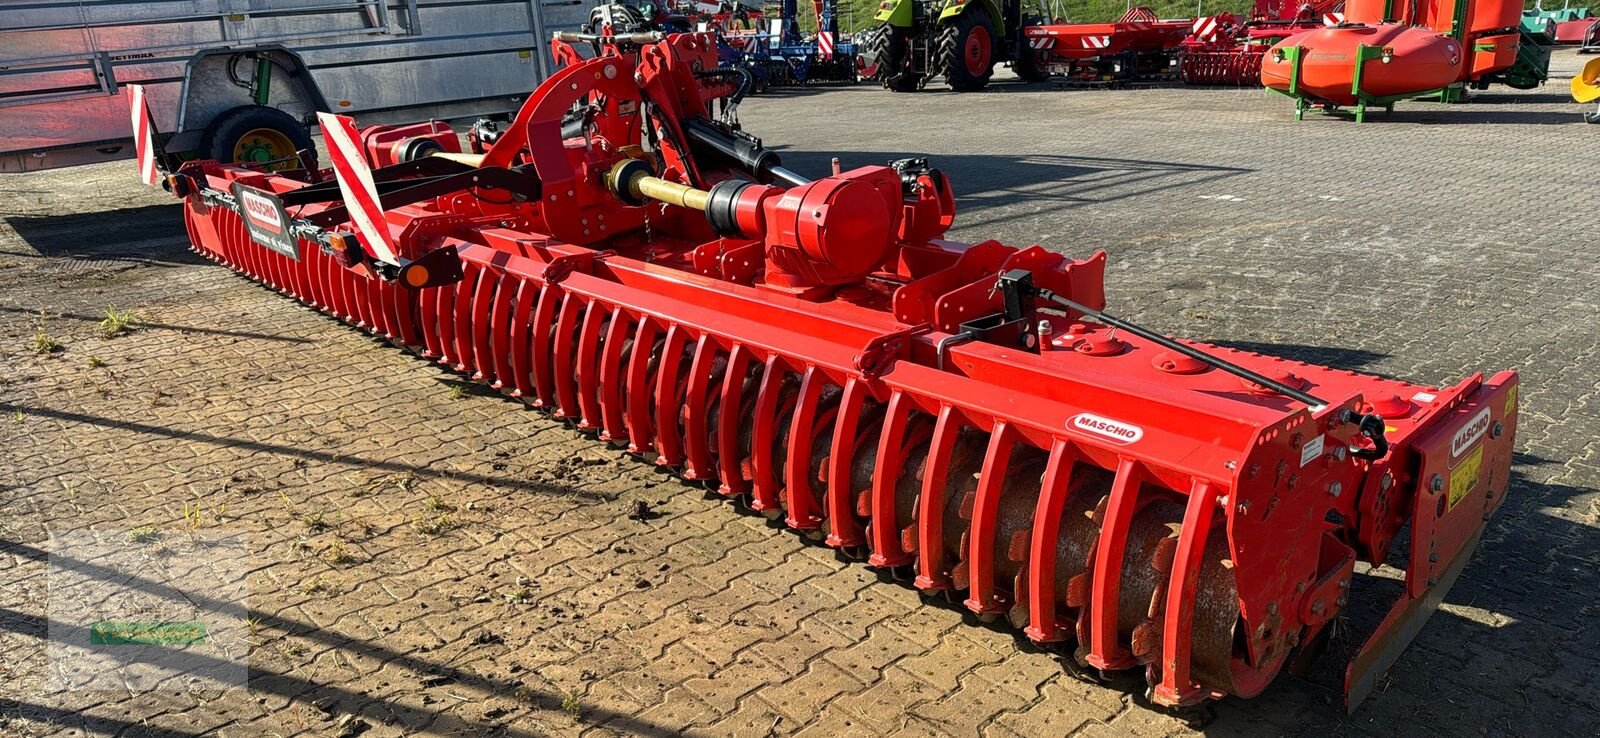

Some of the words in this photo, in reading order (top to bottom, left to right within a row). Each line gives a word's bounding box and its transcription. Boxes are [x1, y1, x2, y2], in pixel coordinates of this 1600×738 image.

[244, 196, 278, 221] MASCHIO
[1078, 417, 1136, 439] MASCHIO
[1454, 413, 1489, 451] MASCHIO
